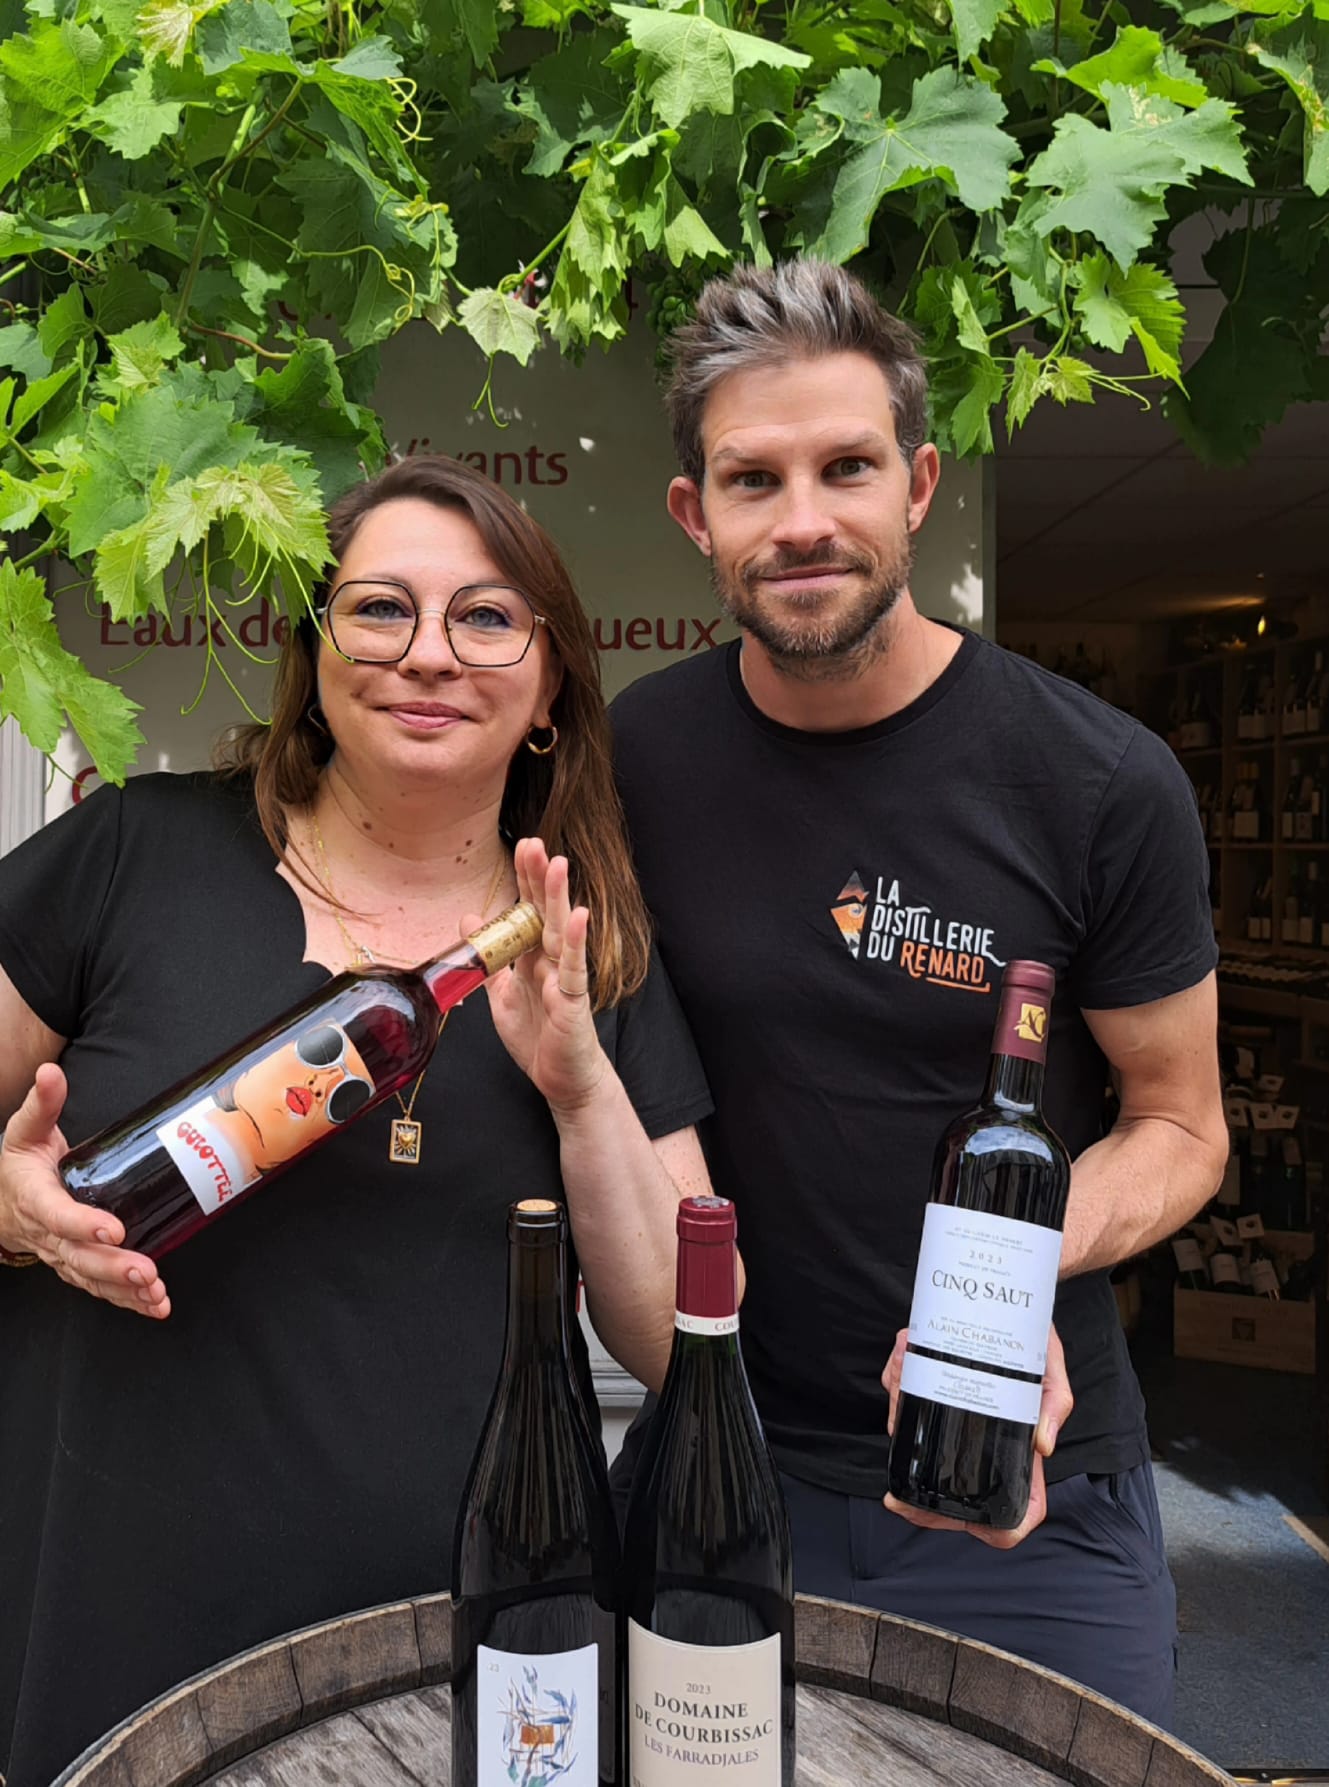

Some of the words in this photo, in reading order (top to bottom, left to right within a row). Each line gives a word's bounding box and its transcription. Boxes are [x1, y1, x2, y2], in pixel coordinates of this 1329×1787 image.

[101, 601, 226, 647] Eaux
[594, 617, 721, 650] ueux
[876, 876, 900, 906] LA
[871, 904, 1007, 967] DISTILLERIE
[866, 931, 895, 961] DU
[900, 940, 989, 986] RENARD
[931, 1269, 979, 1301] CINQ
[982, 1281, 1034, 1308] SAUT
[654, 1691, 749, 1719] DOMAINE
[686, 1682, 712, 1695] 2023
[634, 1703, 652, 1727] DE
[656, 1718, 774, 1743] COURBISSAC
[644, 1734, 664, 1754] LES
[666, 1744, 760, 1768] FARRADJALES
